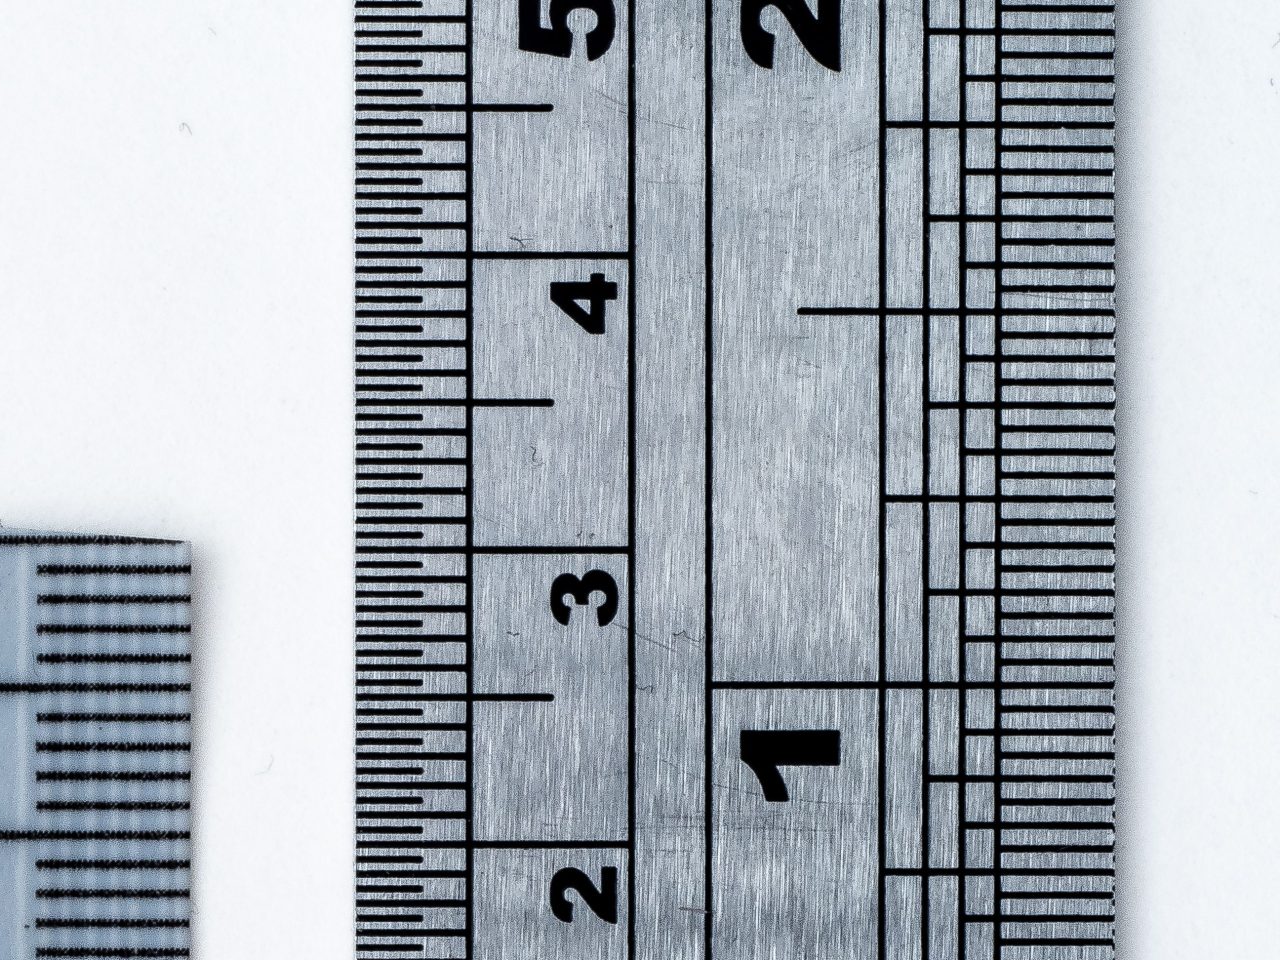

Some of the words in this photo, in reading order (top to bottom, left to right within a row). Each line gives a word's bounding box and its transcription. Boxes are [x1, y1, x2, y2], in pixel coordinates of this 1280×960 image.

[519, 0, 616, 61] 5
[739, 0, 842, 72] 2
[550, 272, 618, 334] 4
[550, 568, 619, 627] 3
[740, 729, 841, 802] 1
[550, 866, 618, 924] 2
